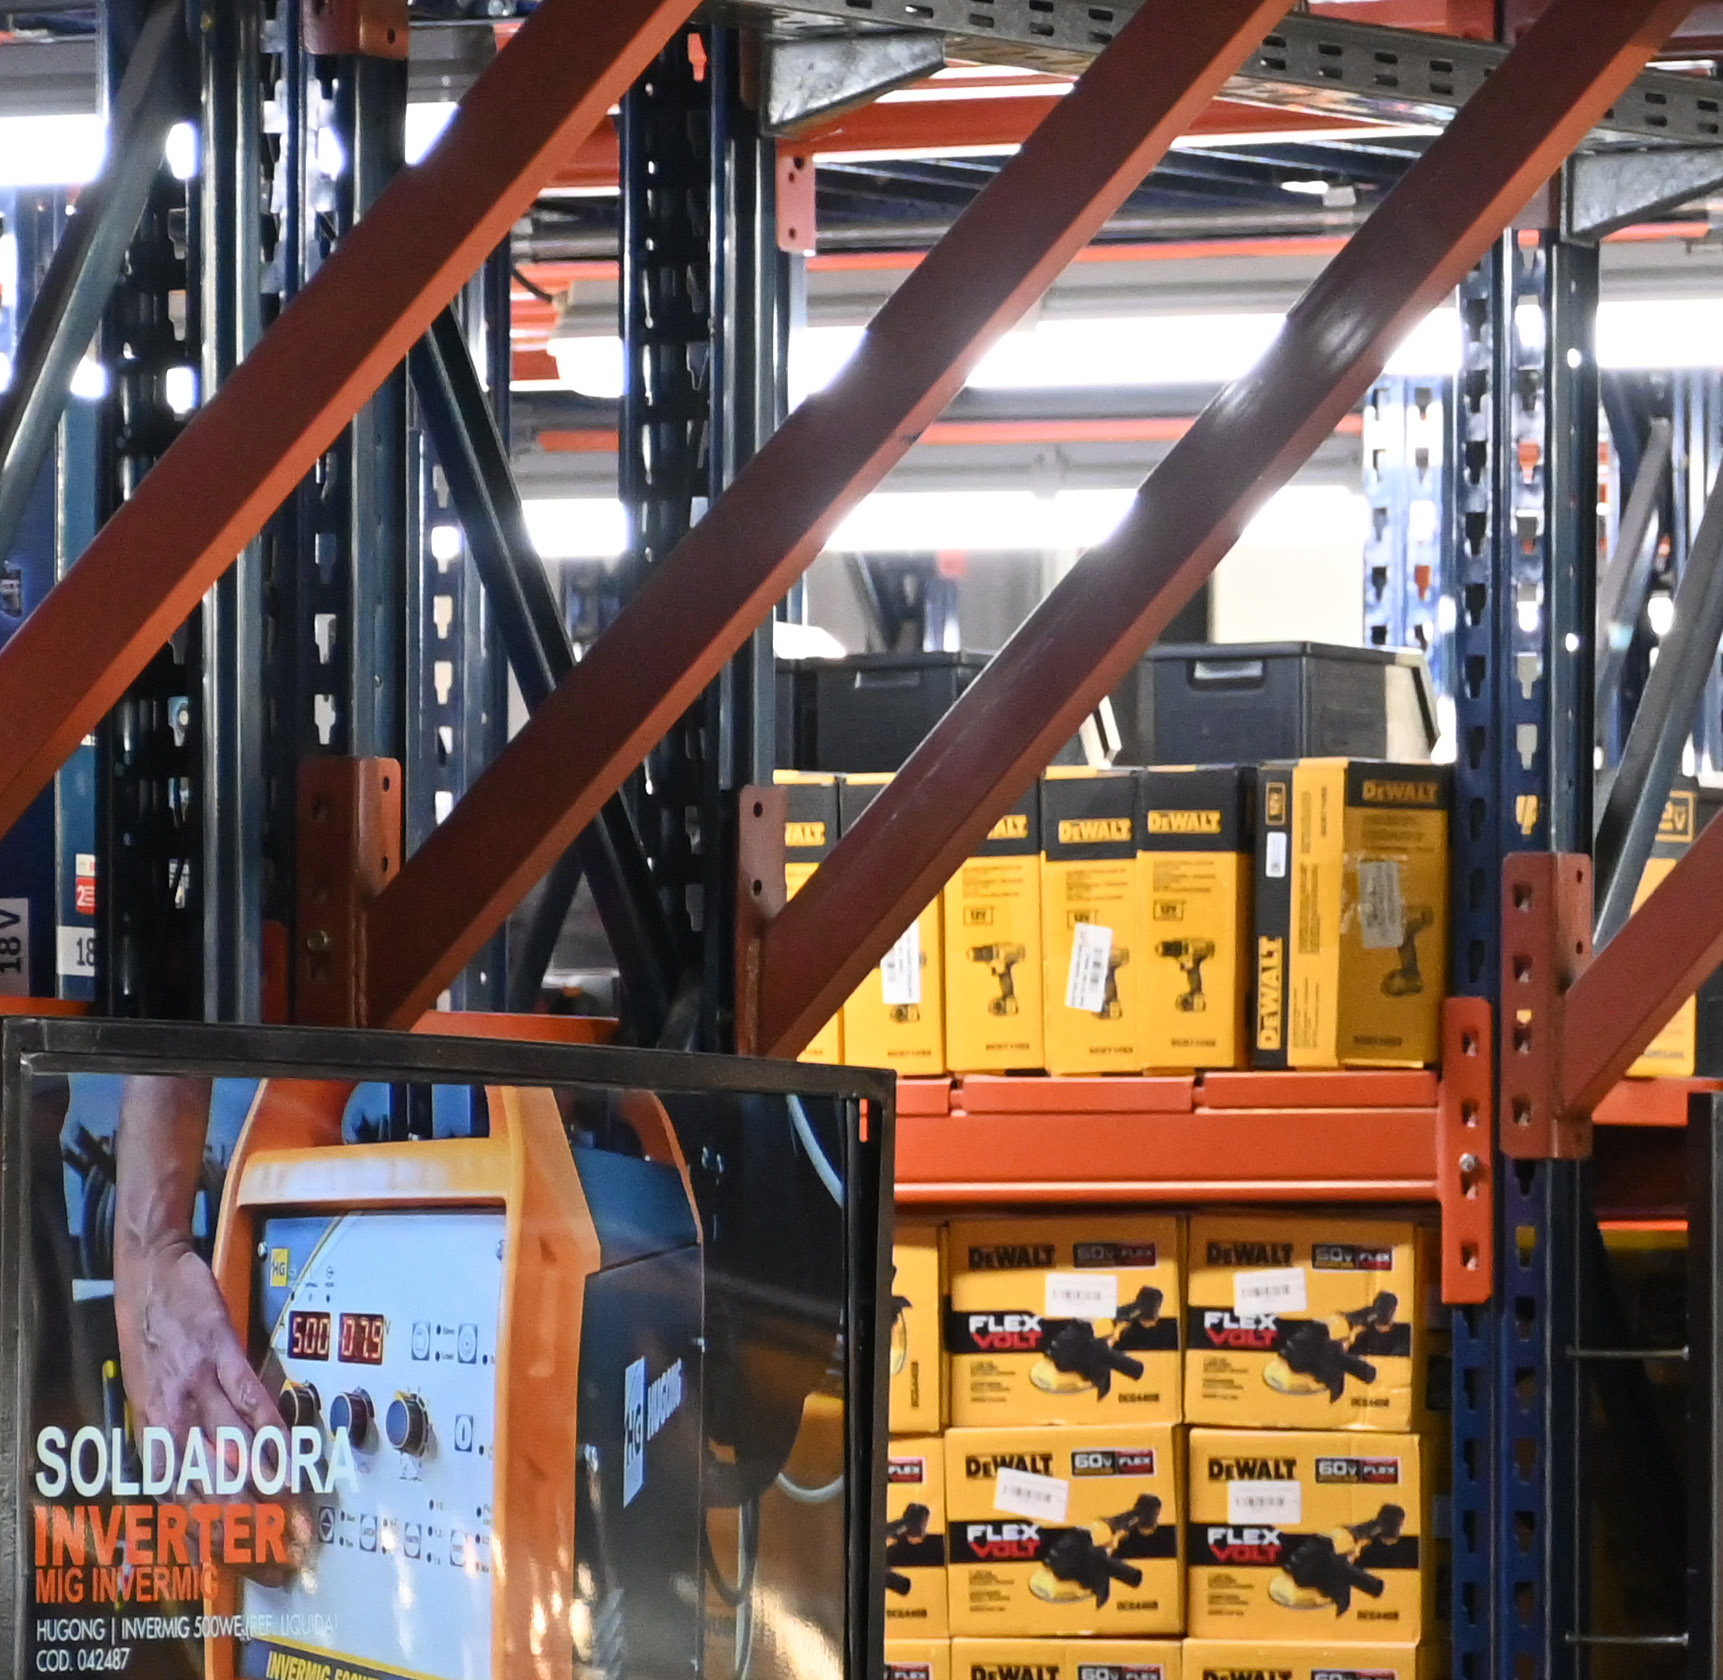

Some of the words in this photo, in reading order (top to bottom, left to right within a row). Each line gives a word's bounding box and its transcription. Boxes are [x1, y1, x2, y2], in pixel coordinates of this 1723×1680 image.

[1363, 779, 1439, 803] DEWALT
[1059, 818, 1133, 844] DEWALT
[1148, 810, 1222, 835] DEWALT
[1258, 936, 1283, 1051] DEWALT
[968, 1315, 1042, 1332] FLEX
[1204, 1311, 1278, 1330] FLEX
[293, 1318, 330, 1353] 500
[971, 1330, 1043, 1349] VOLT
[1206, 1328, 1279, 1347] VOLT
[36, 1426, 359, 1497] SOLDADORA
[966, 1454, 1053, 1479] DEWALT
[1119, 1455, 1151, 1466] FLEX
[1208, 1456, 1297, 1480] DEWALT
[34, 1503, 289, 1566] INVERTER
[967, 1524, 1041, 1541] FLEX
[1207, 1526, 1282, 1545] FLEX
[969, 1539, 1042, 1558] VOLT
[1209, 1543, 1282, 1562] VOLT
[35, 1567, 84, 1603] MIG
[92, 1566, 219, 1602] INVERMIG
[37, 1619, 105, 1642] HUGONG
[121, 1617, 190, 1639] INVERMIG
[36, 1651, 73, 1672] COD.
[77, 1649, 130, 1671] 042487
[894, 1670, 927, 1680] FLEX
